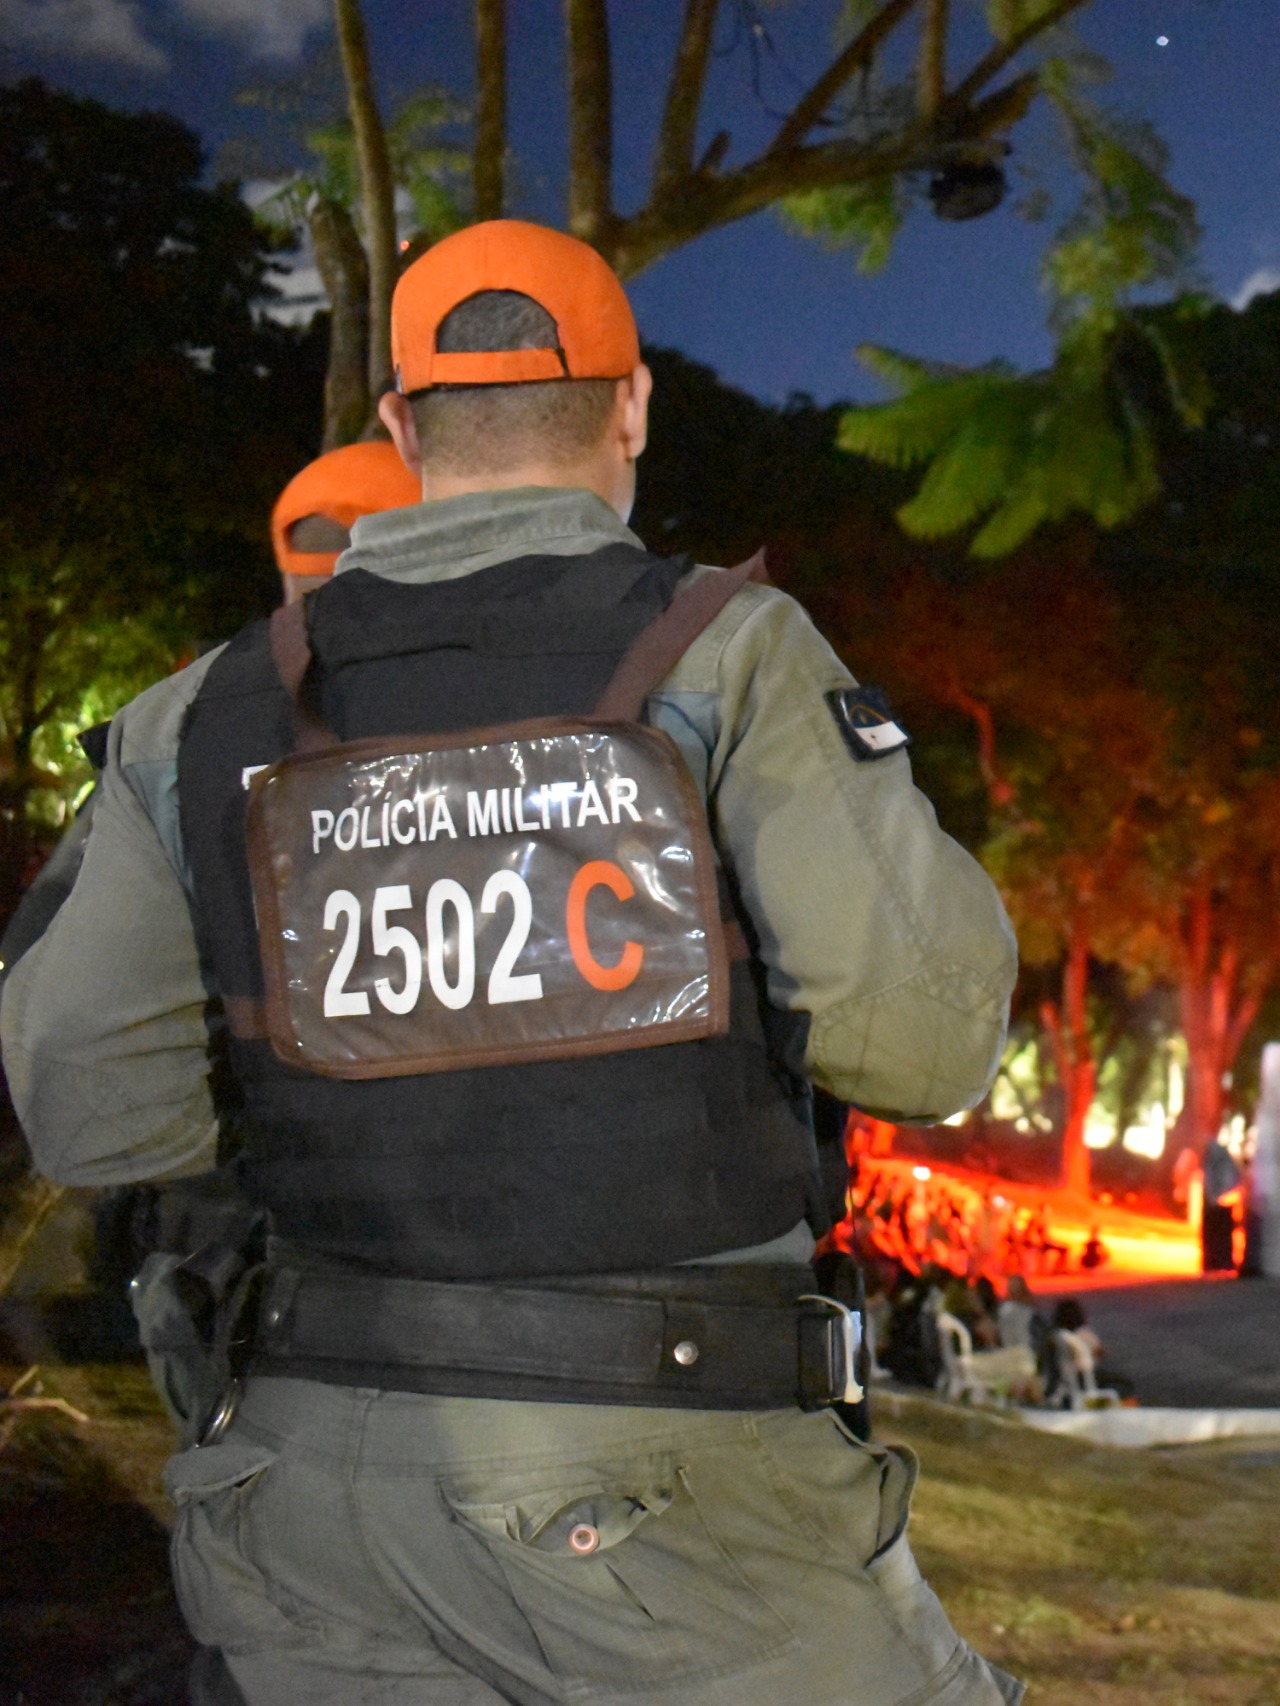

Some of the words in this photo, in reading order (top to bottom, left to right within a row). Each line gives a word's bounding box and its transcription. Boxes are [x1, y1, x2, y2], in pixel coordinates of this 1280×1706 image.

[311, 788, 458, 854] POLÍCIA
[467, 777, 642, 837] MILITAR
[323, 869, 543, 1018] 2502
[566, 860, 644, 992] C
